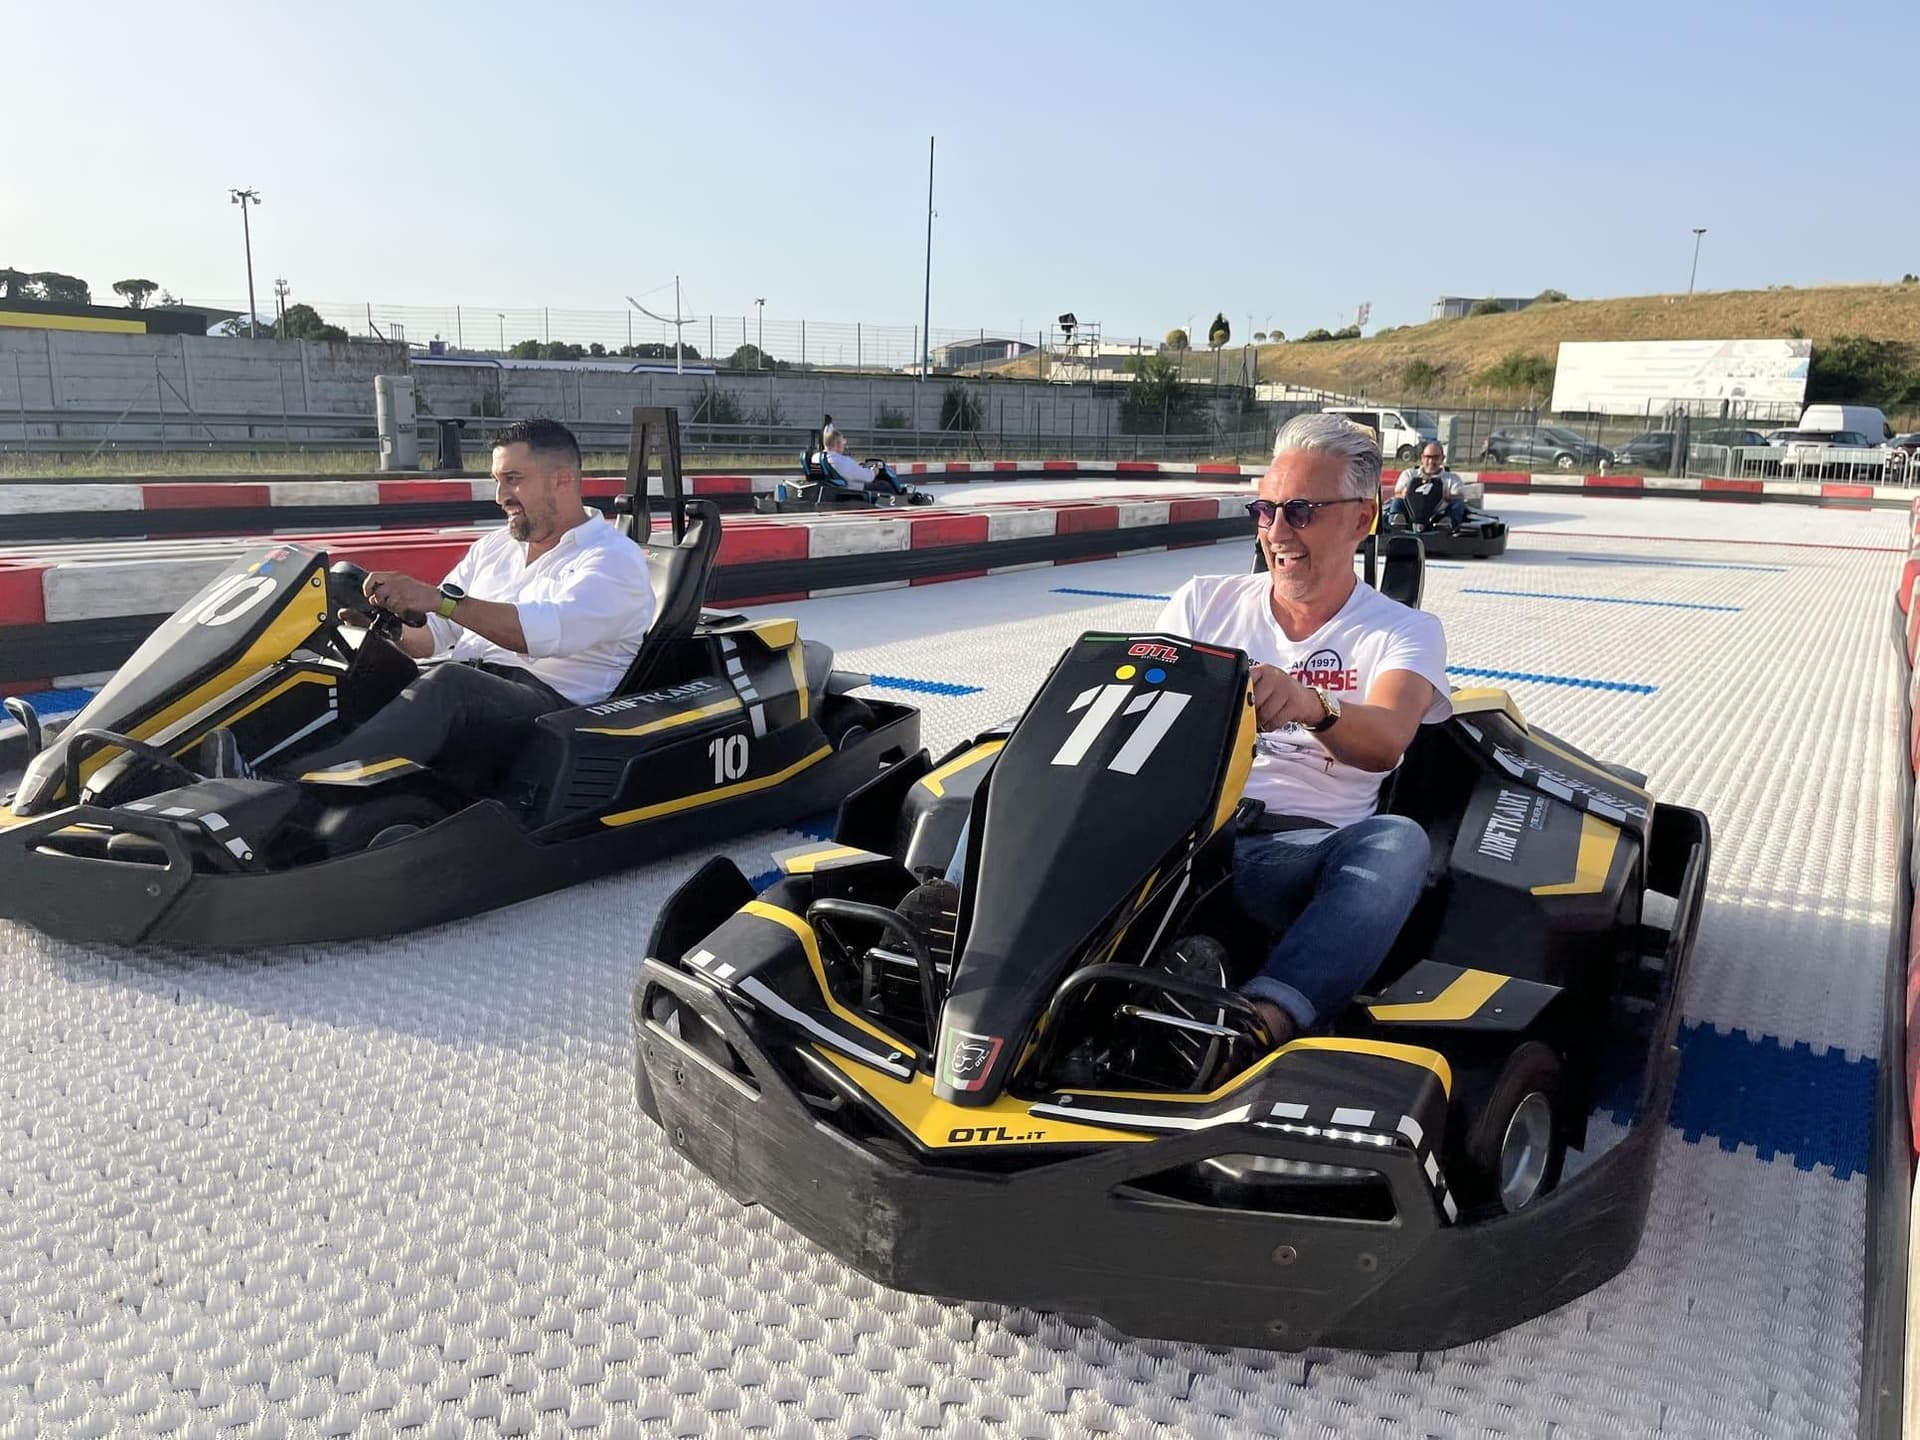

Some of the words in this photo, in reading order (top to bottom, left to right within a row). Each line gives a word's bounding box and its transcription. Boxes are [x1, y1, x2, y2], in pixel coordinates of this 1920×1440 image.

[178, 573, 278, 627] 10
[1128, 643, 1179, 661] OTL
[1311, 658, 1337, 668] 1997
[1050, 684, 1193, 776] 11
[708, 734, 749, 785] 10
